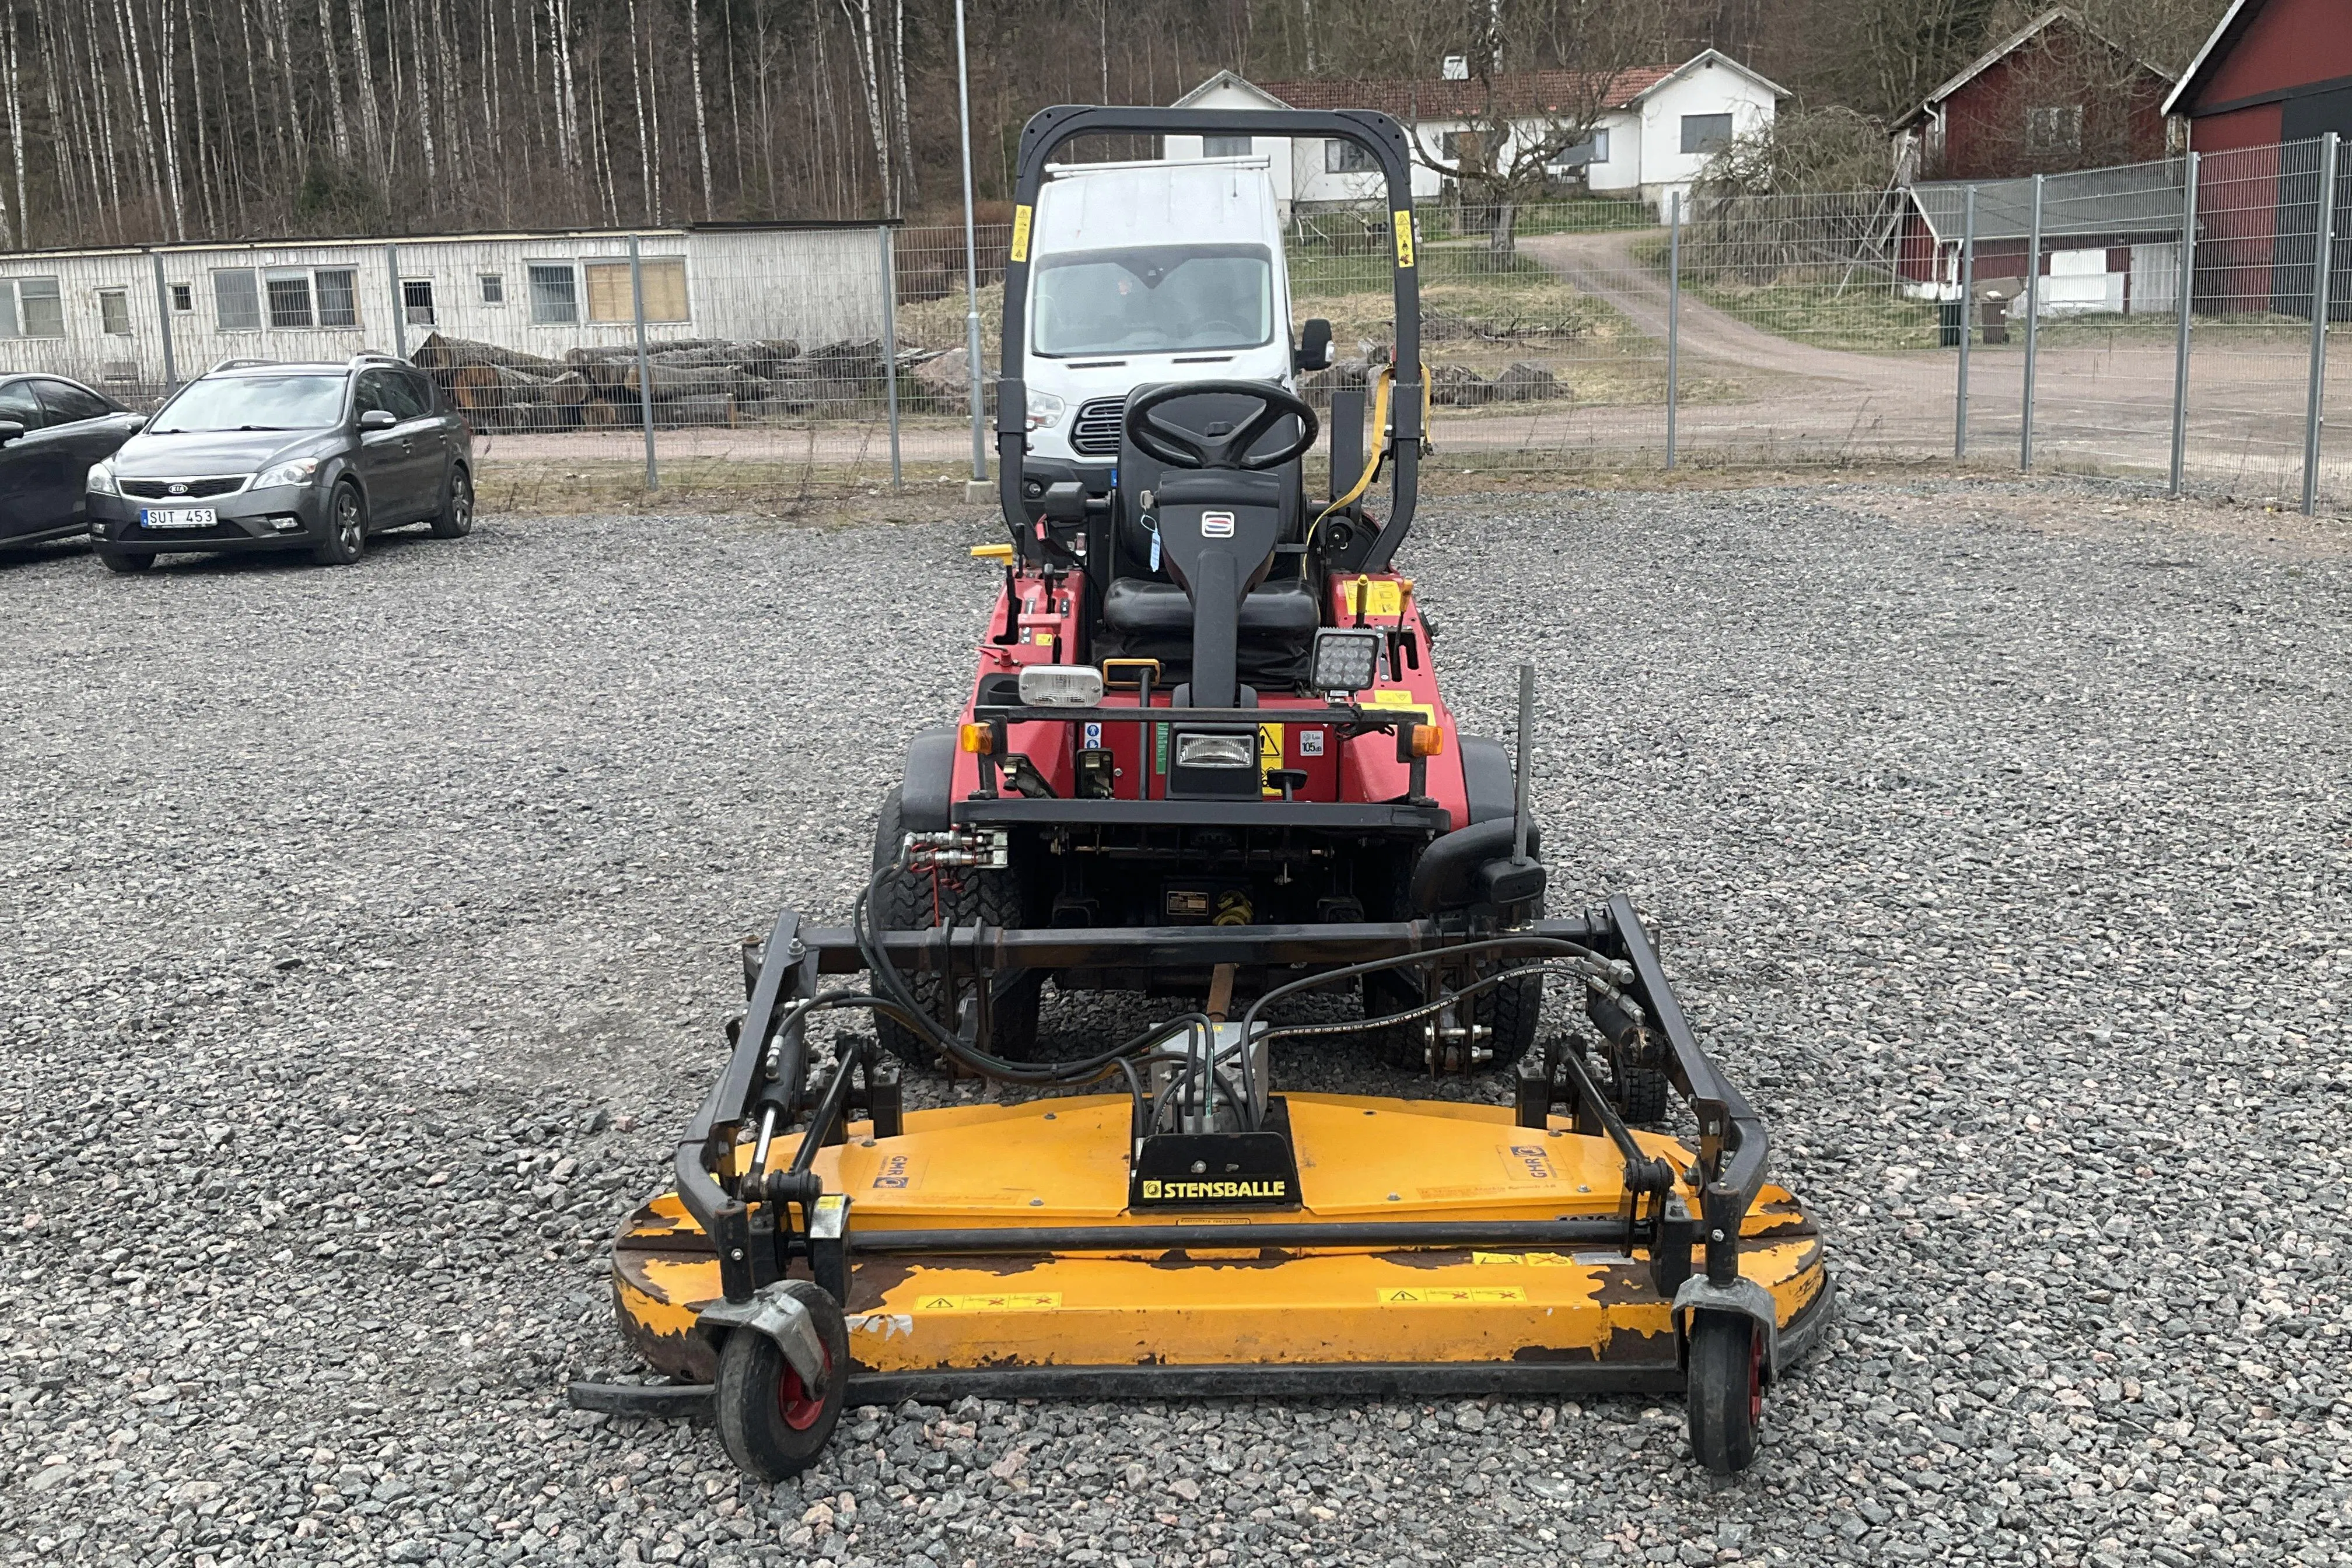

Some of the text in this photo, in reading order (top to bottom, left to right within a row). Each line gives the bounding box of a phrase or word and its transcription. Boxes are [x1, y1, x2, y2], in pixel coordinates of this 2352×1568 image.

[170, 485, 187, 493] KIA
[149, 510, 212, 523] SUT 453
[887, 1156, 908, 1176] GMR
[1525, 1158, 1548, 1178] GMR
[1164, 1181, 1284, 1198] STENSBALLE
